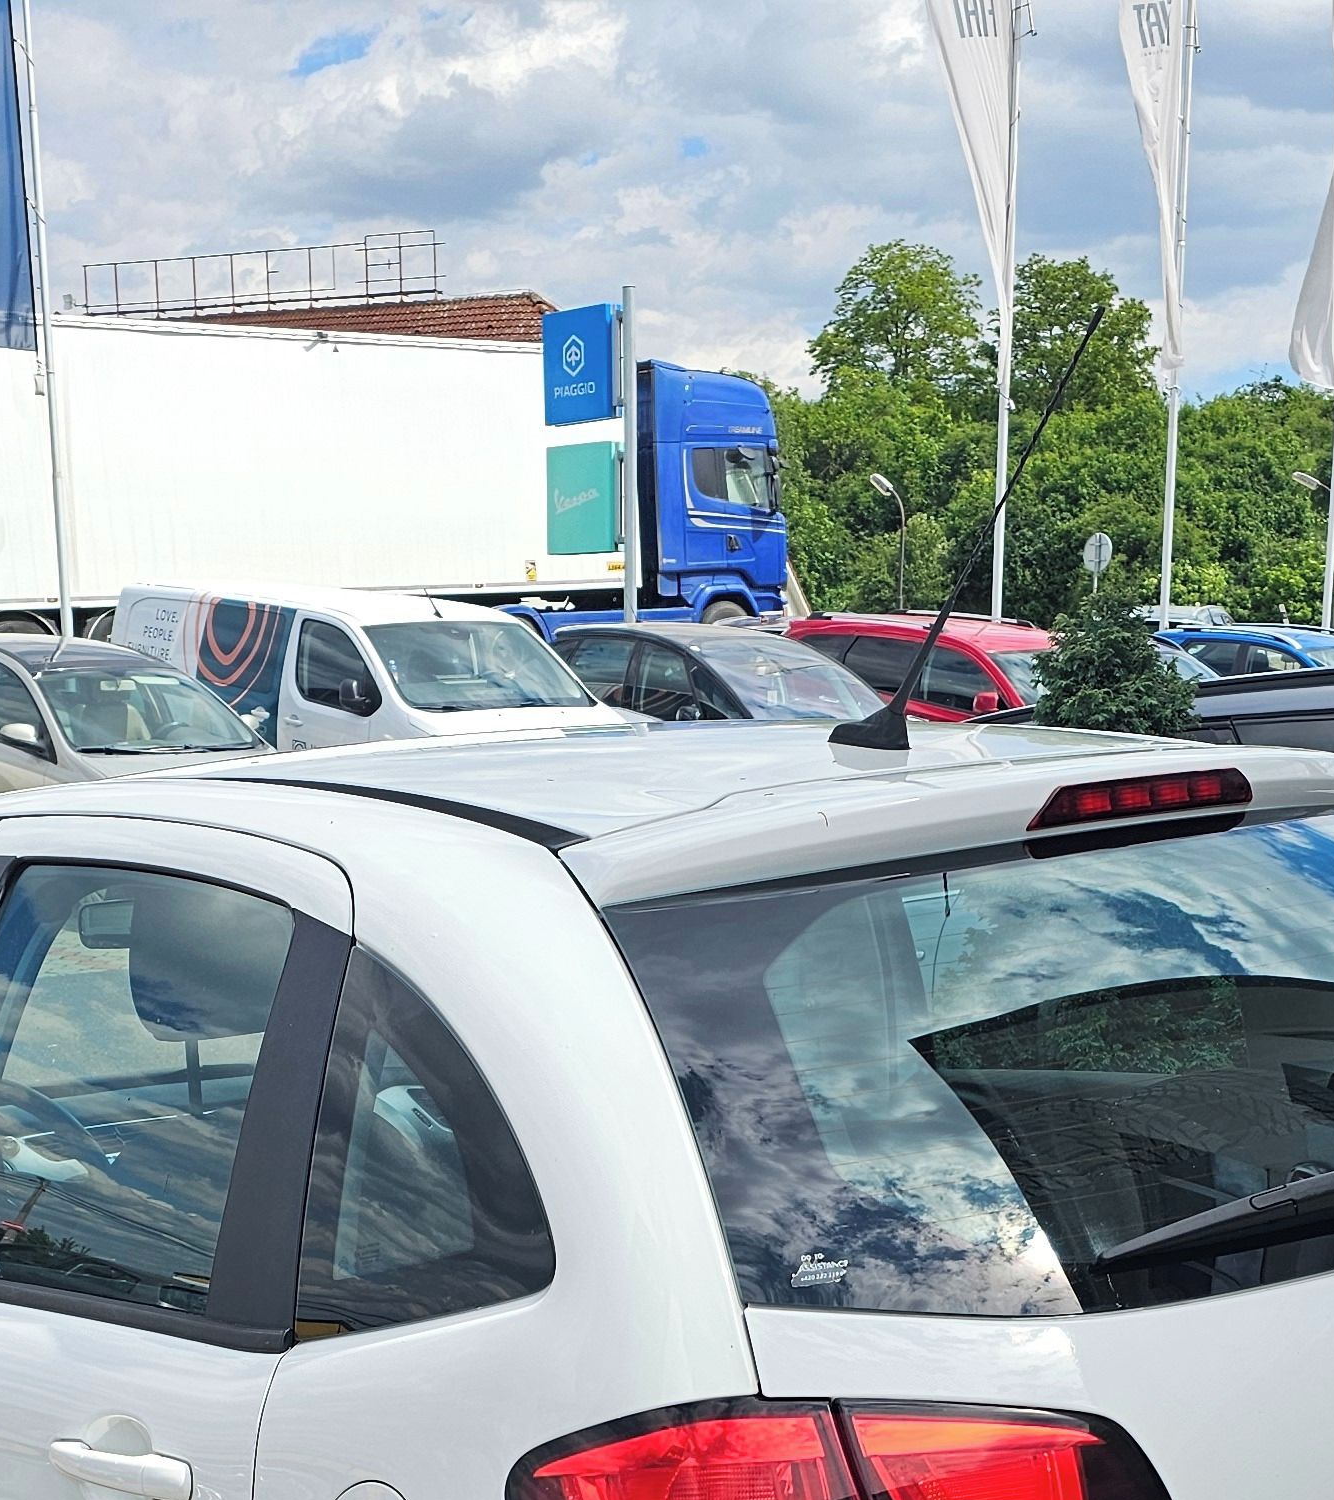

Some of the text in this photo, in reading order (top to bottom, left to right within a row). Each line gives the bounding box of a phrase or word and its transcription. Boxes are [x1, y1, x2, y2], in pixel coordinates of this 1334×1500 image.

[554, 381, 596, 398] PIAGGIO
[554, 488, 600, 514] Vespa
[156, 608, 178, 623] LOVE.
[143, 625, 174, 642] PEOPLE.
